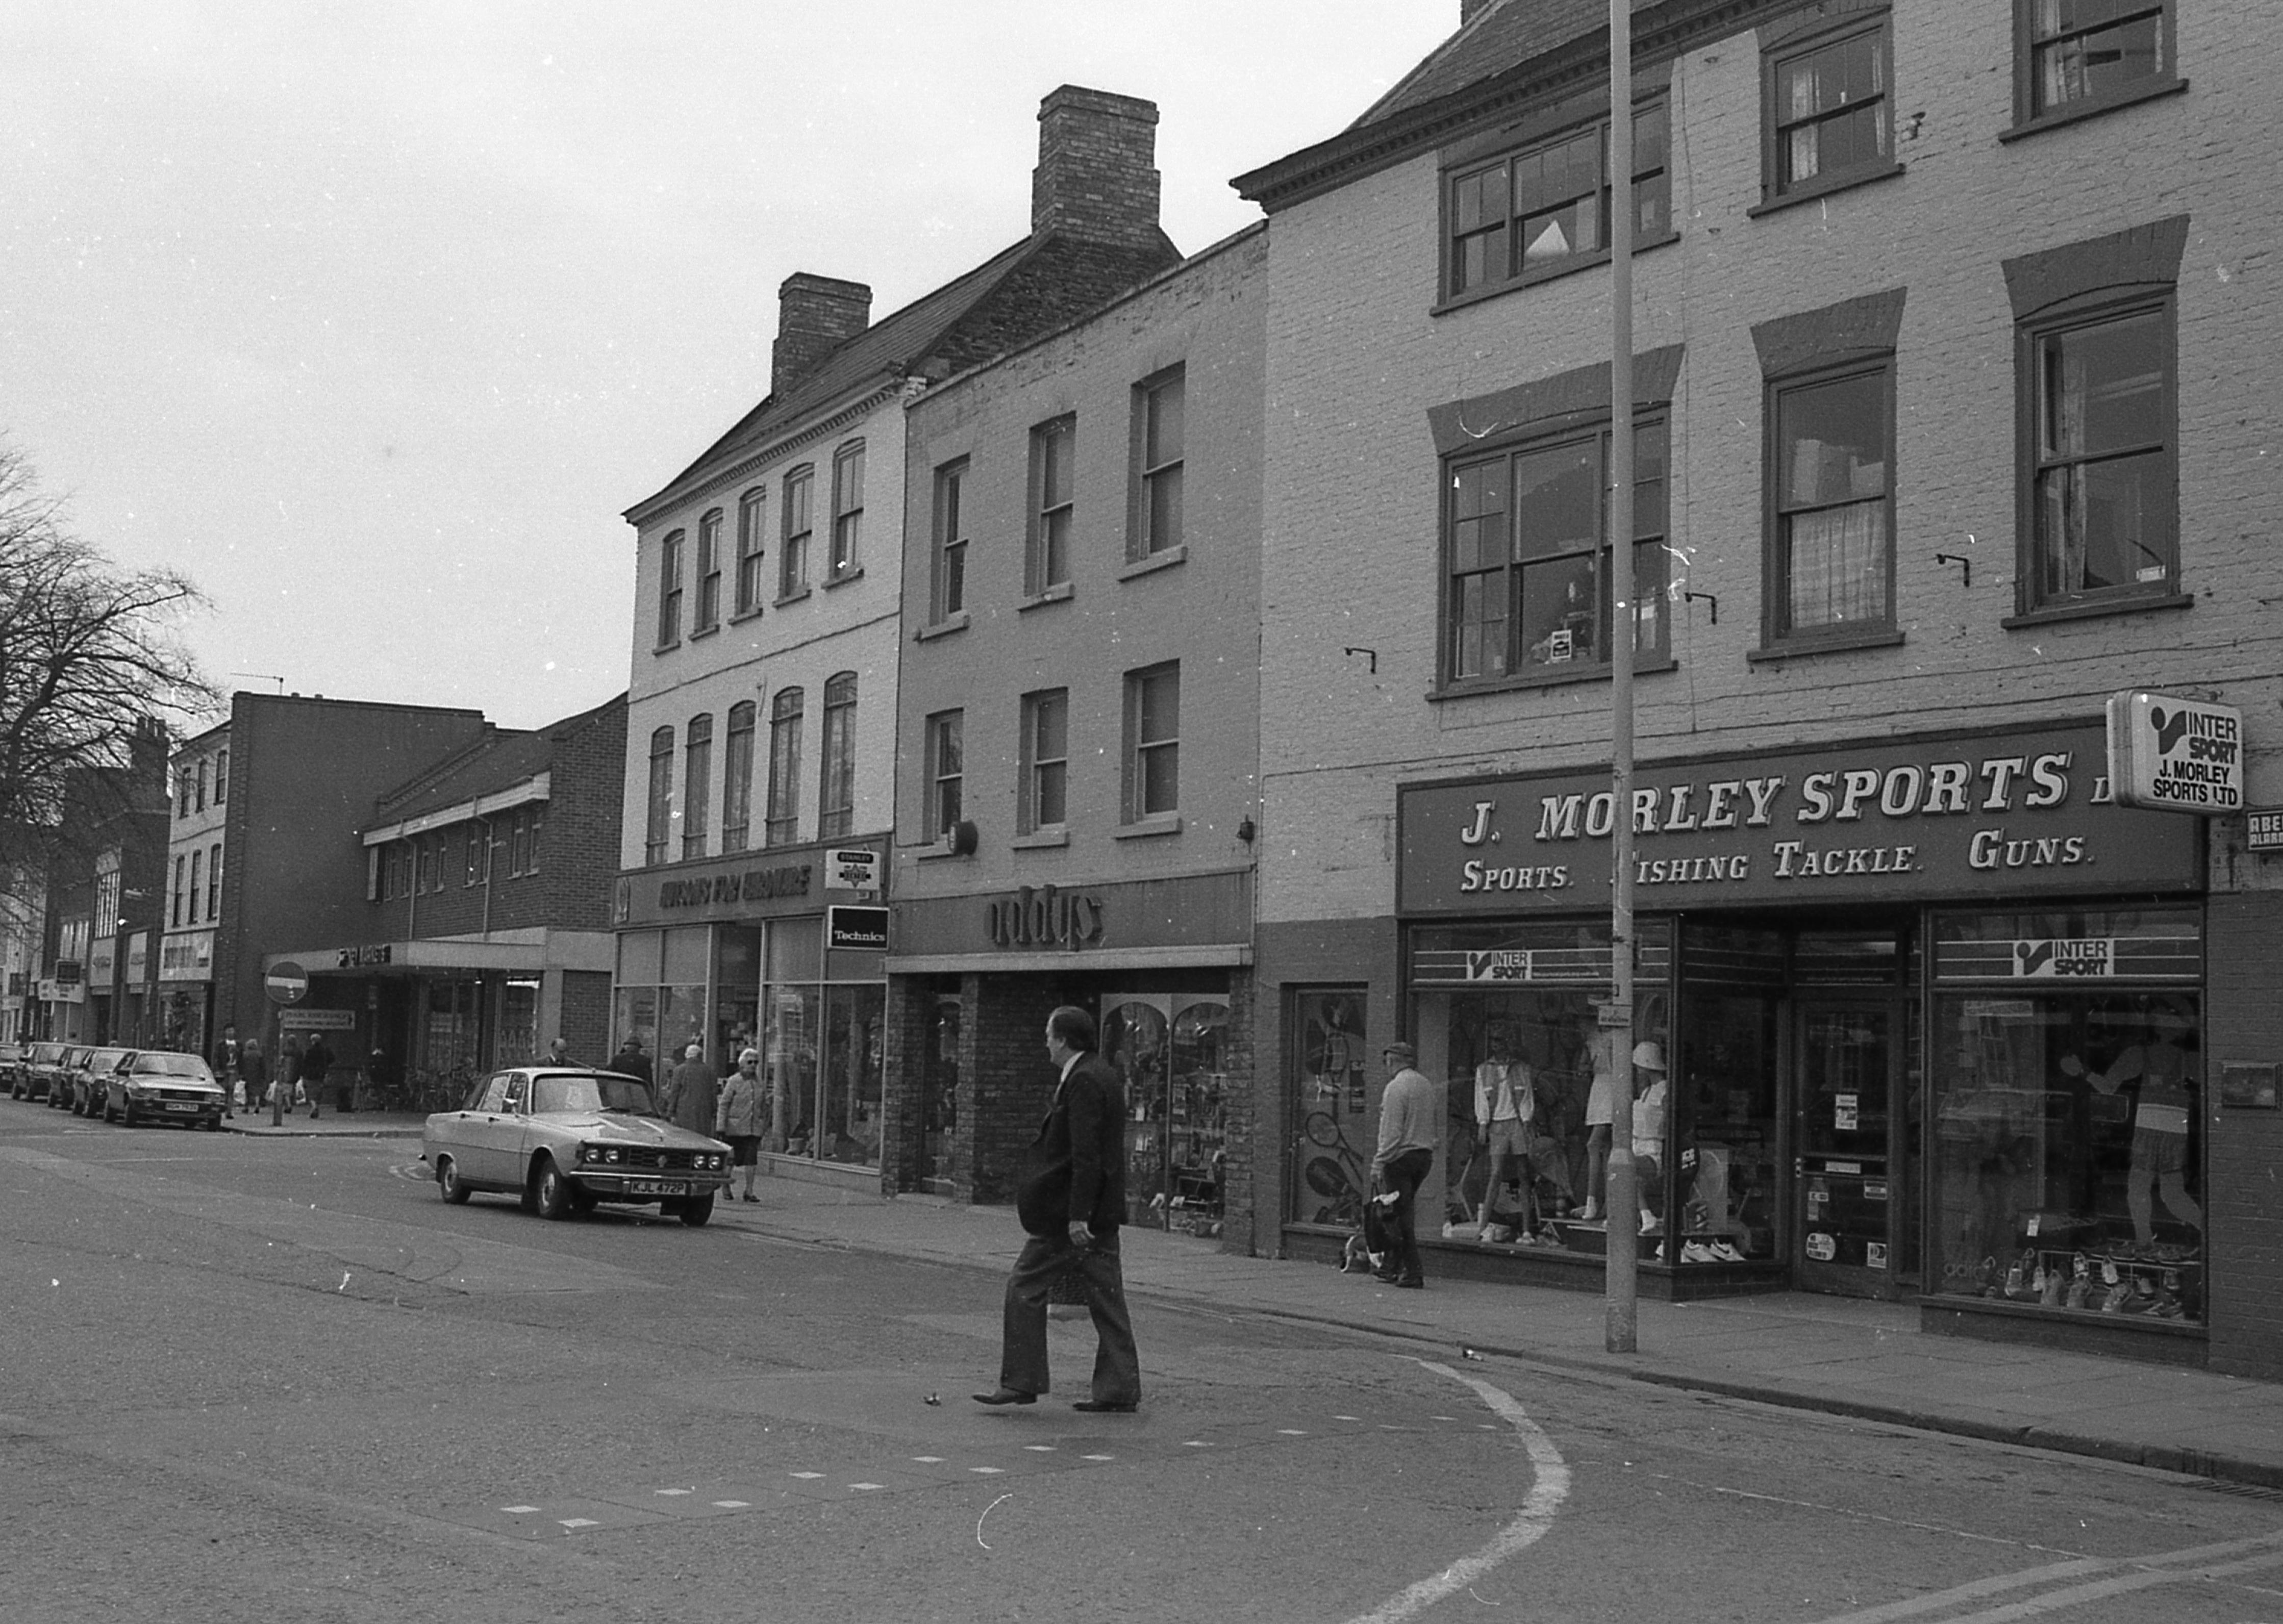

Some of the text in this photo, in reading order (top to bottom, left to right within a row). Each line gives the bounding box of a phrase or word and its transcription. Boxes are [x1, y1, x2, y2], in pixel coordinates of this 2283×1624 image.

[2188, 712, 2237, 741] INTER
[2189, 737, 2238, 765] SPORT
[2159, 759, 2229, 785] J. MORLEY
[1461, 801, 1500, 845] J.
[1535, 776, 1785, 841] MORLEY
[1797, 752, 2072, 822] SPORTS
[2153, 779, 2238, 806] SPORTS LTD
[2250, 816, 2283, 833] ABE
[1609, 850, 1749, 885] ISHING
[834, 930, 885, 941] Technics
[2054, 941, 2108, 958] INTER
[1492, 952, 1528, 966] INTER
[2054, 959, 2108, 975] SPORT
[1492, 966, 1528, 979] SPORT
[633, 1183, 684, 1193] KJL 472P
